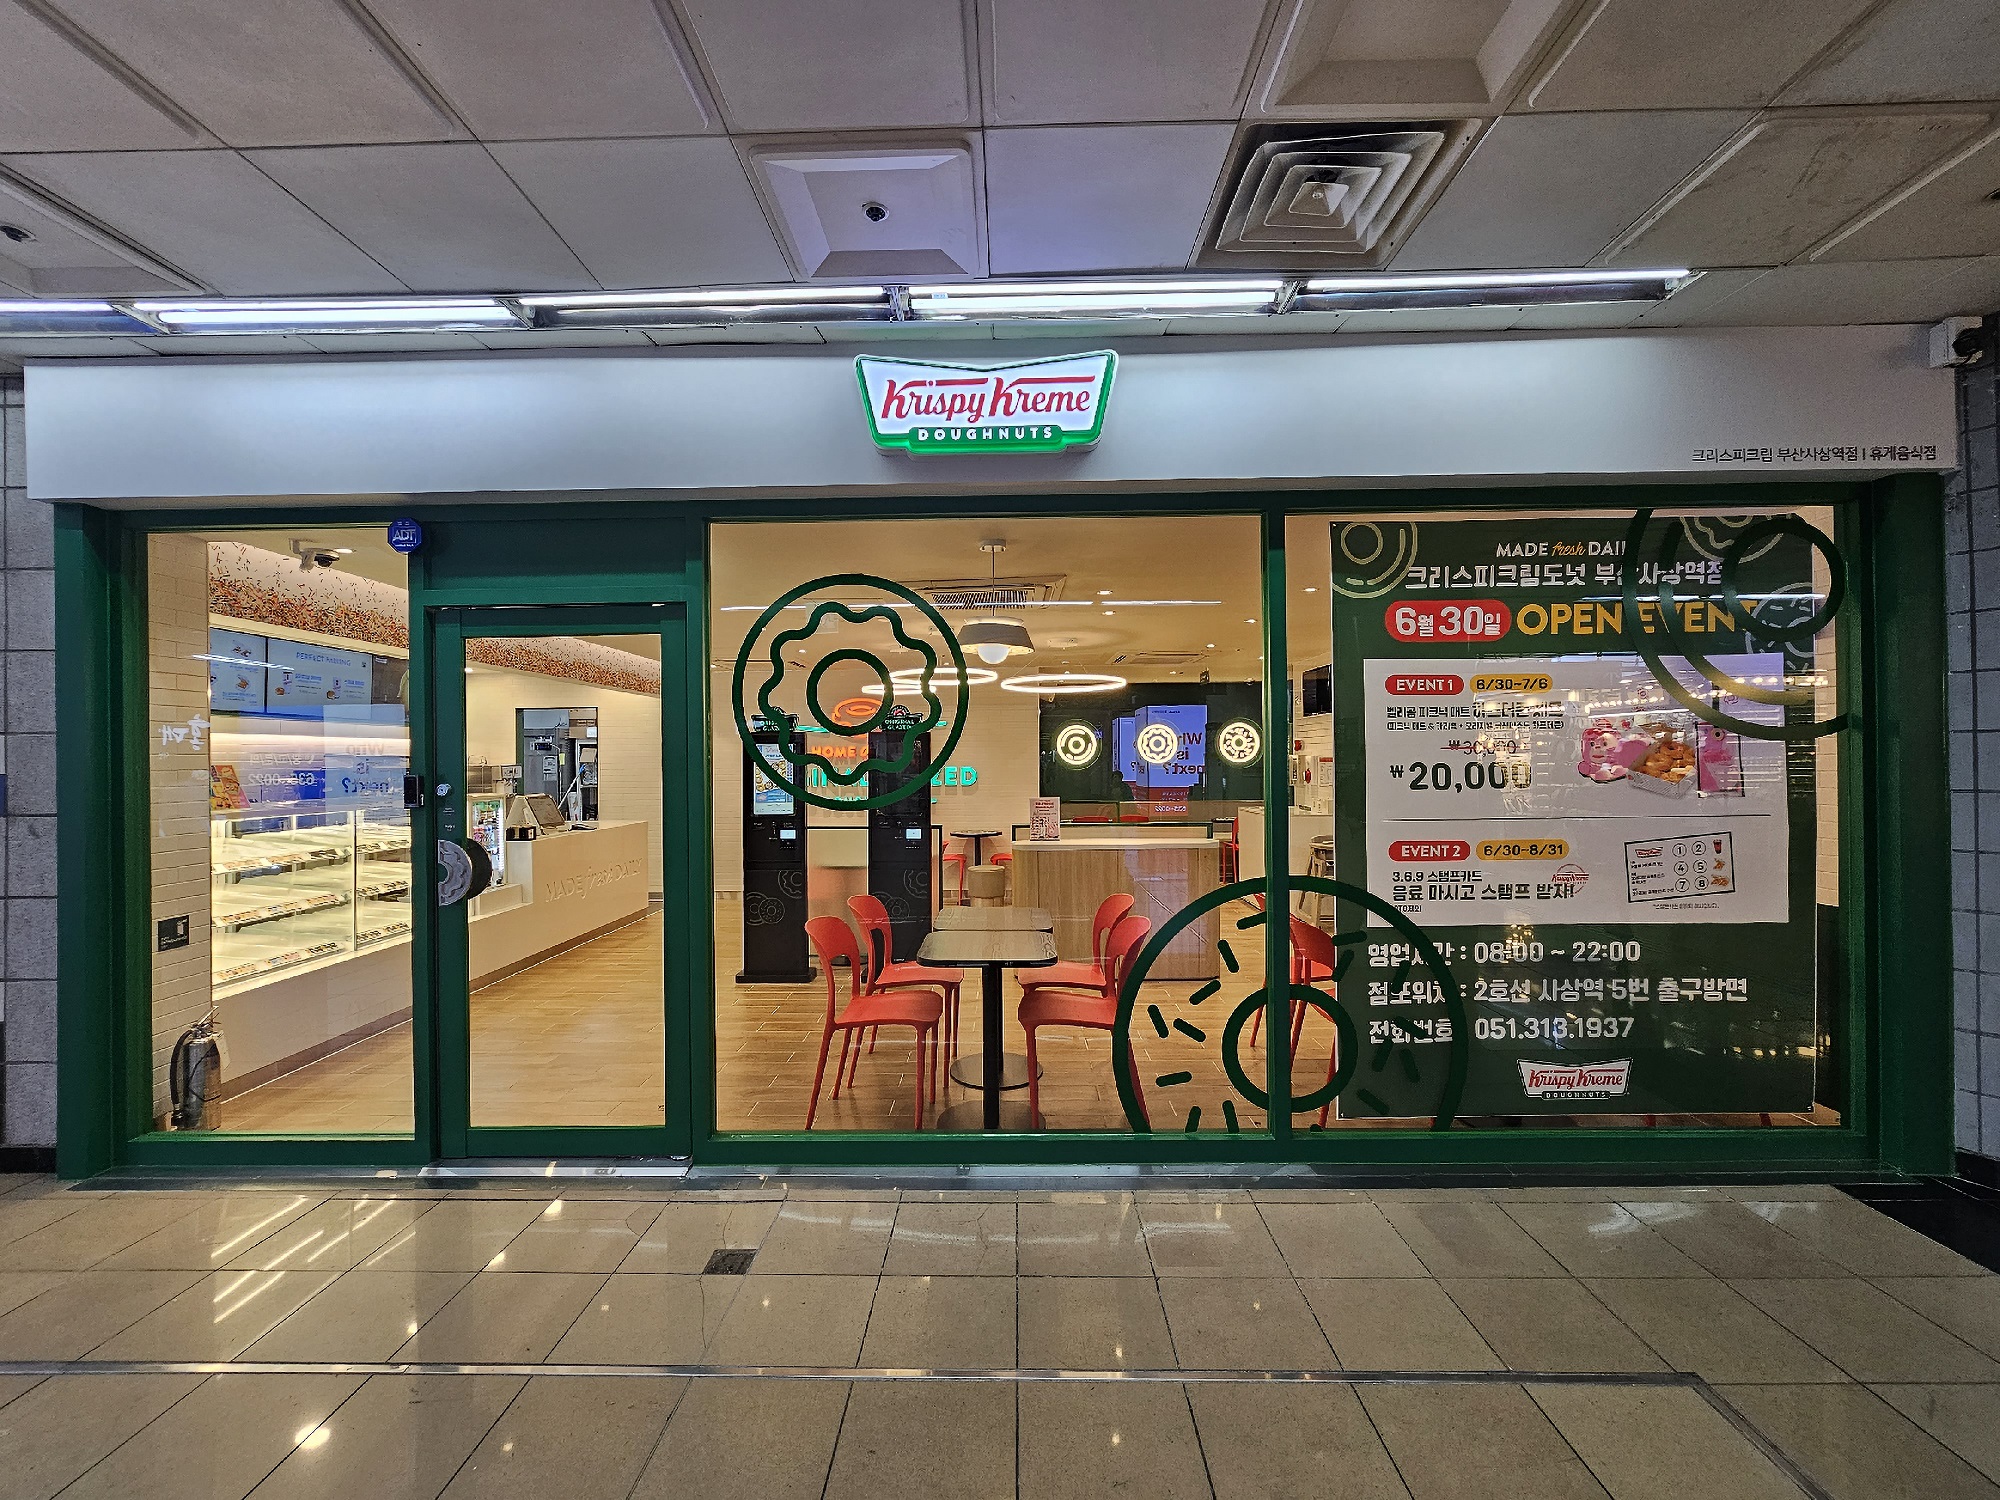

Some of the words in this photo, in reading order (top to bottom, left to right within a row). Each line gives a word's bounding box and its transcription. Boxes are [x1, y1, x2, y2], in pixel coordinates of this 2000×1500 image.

[881, 377, 989, 423] Krispy
[988, 375, 1096, 417] Kreme
[917, 426, 1053, 441] DOUGHNUTS
[1692, 448, 1773, 463] 크리스피크림
[1776, 447, 1858, 462] 부산사상역점
[1869, 445, 1937, 461] 휴게음식점
[393, 529, 416, 541] ADT
[1496, 541, 1549, 558] MADE
[1551, 541, 1587, 557] fresh
[1588, 540, 1627, 556] DAI
[1405, 563, 1586, 589] 크리스피크림도넛
[1395, 606, 1434, 637] 6월
[1438, 606, 1502, 637] 30일
[1516, 602, 1623, 635] OPEN
[1397, 679, 1444, 691] EVENT
[1448, 679, 1454, 691] 1
[1476, 678, 1548, 690] 6/30~7/6
[1401, 845, 1449, 857] EVENT
[1453, 845, 1461, 857] 2
[1484, 844, 1564, 857] 6/30~8/31
[1392, 871, 1424, 883] 3.6.9
[1426, 870, 1483, 883] 스탬프카드
[1392, 884, 1424, 902] 음료
[1428, 884, 1476, 902] 마시고
[1481, 883, 1531, 901] 스탬프
[1474, 941, 1544, 964] 08:00
[1572, 941, 1641, 962] 22:00
[1474, 978, 1531, 1003] 2호선
[1539, 978, 1605, 1002] 사상역
[1611, 978, 1650, 1002] 5번
[1658, 977, 1748, 1002] 출구방면
[1474, 1016, 1635, 1041] 051.313.1937
[1528, 1068, 1577, 1090] Krispy
[1576, 1068, 1626, 1087] Kreme
[1546, 1091, 1606, 1099] DOUGHNUTS
